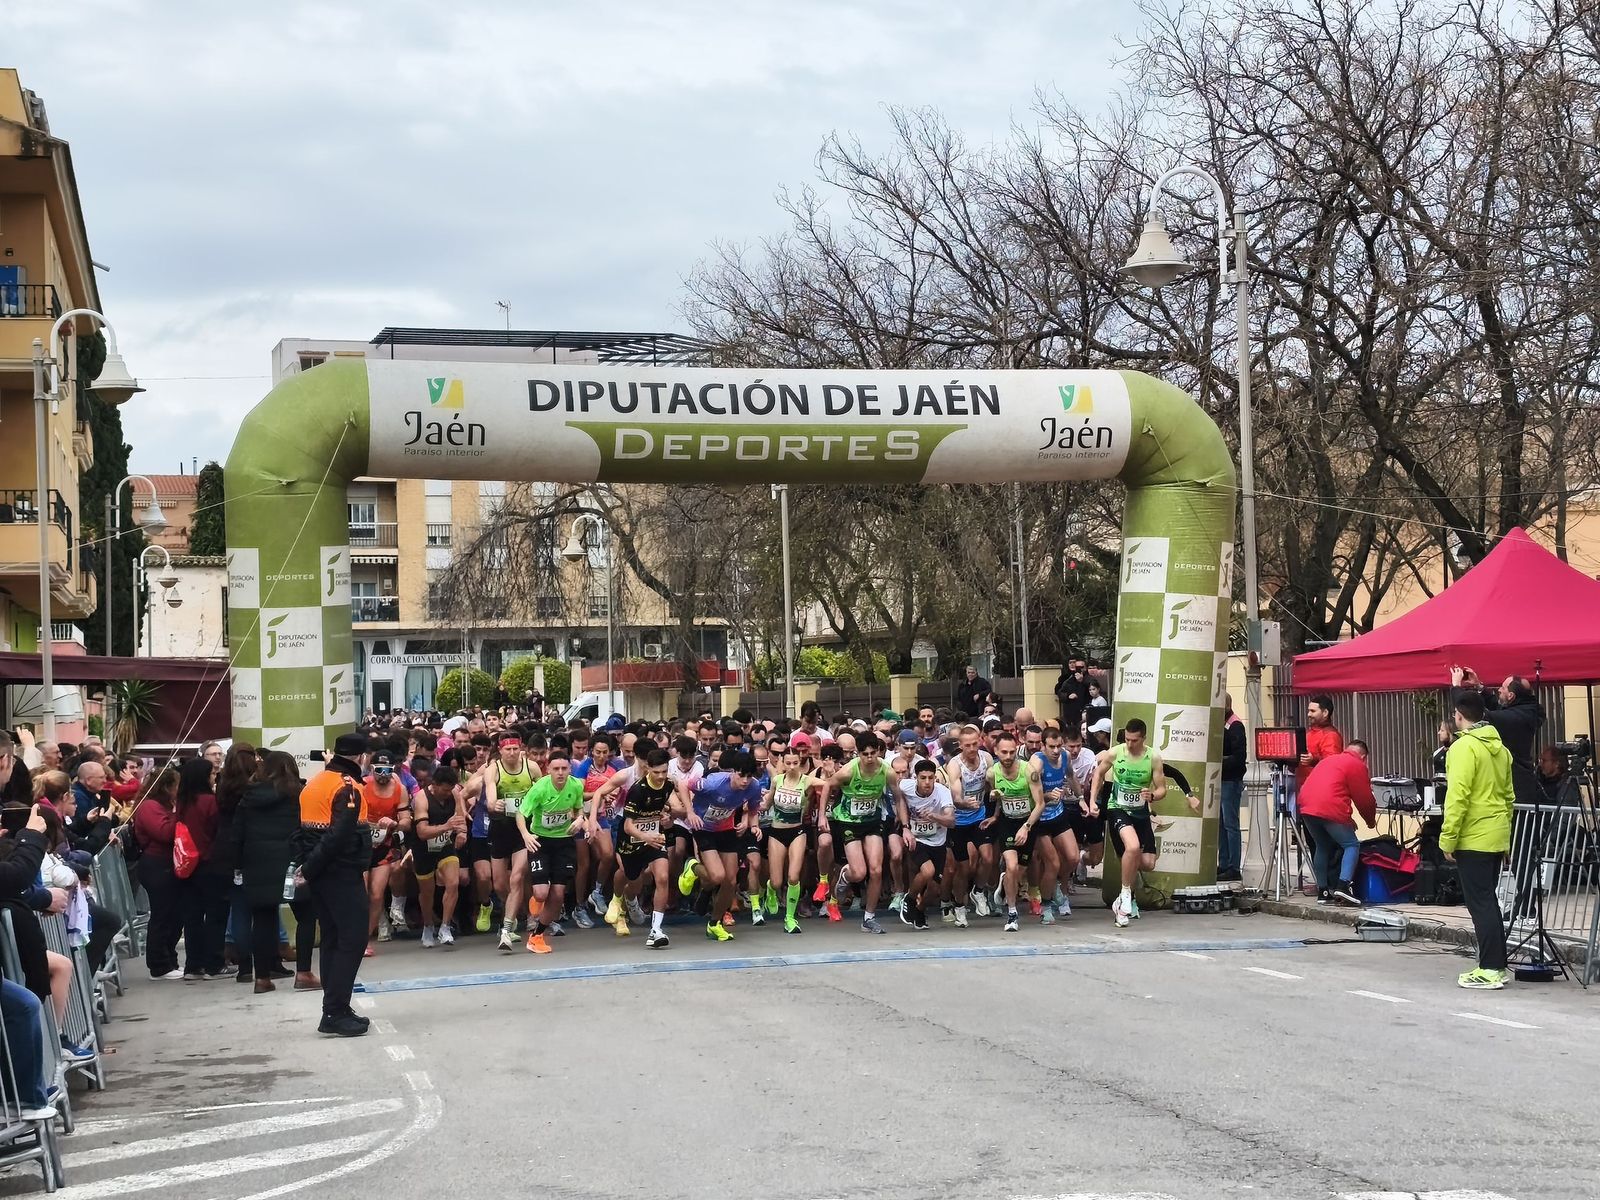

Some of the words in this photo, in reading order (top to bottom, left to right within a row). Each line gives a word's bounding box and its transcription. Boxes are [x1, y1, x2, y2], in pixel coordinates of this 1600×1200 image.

[527, 379, 810, 416] DIPUTACIÓN
[822, 384, 881, 416] DE
[892, 380, 1000, 416] JAÉN
[404, 411, 486, 447] Jaén
[1039, 417, 1113, 450] Jaén
[613, 428, 920, 461] DEPORTES
[446, 448, 485, 457] interior
[1075, 450, 1111, 460] interior
[1174, 562, 1215, 571] DEPORTES
[1180, 618, 1213, 627] DIPUTACIÓN
[277, 633, 318, 641] DIPUTACIÓN
[1165, 673, 1208, 682] DEPORTES
[268, 693, 317, 701] DEPORTES
[1171, 729, 1205, 737] DIPUTACIÓN
[778, 794, 799, 806] 1334
[1124, 793, 1140, 803] 698
[1004, 801, 1027, 811] 1152
[546, 813, 568, 825] 1274
[636, 821, 656, 832] 1299
[914, 822, 934, 833] 1296
[530, 859, 543, 873] 21
